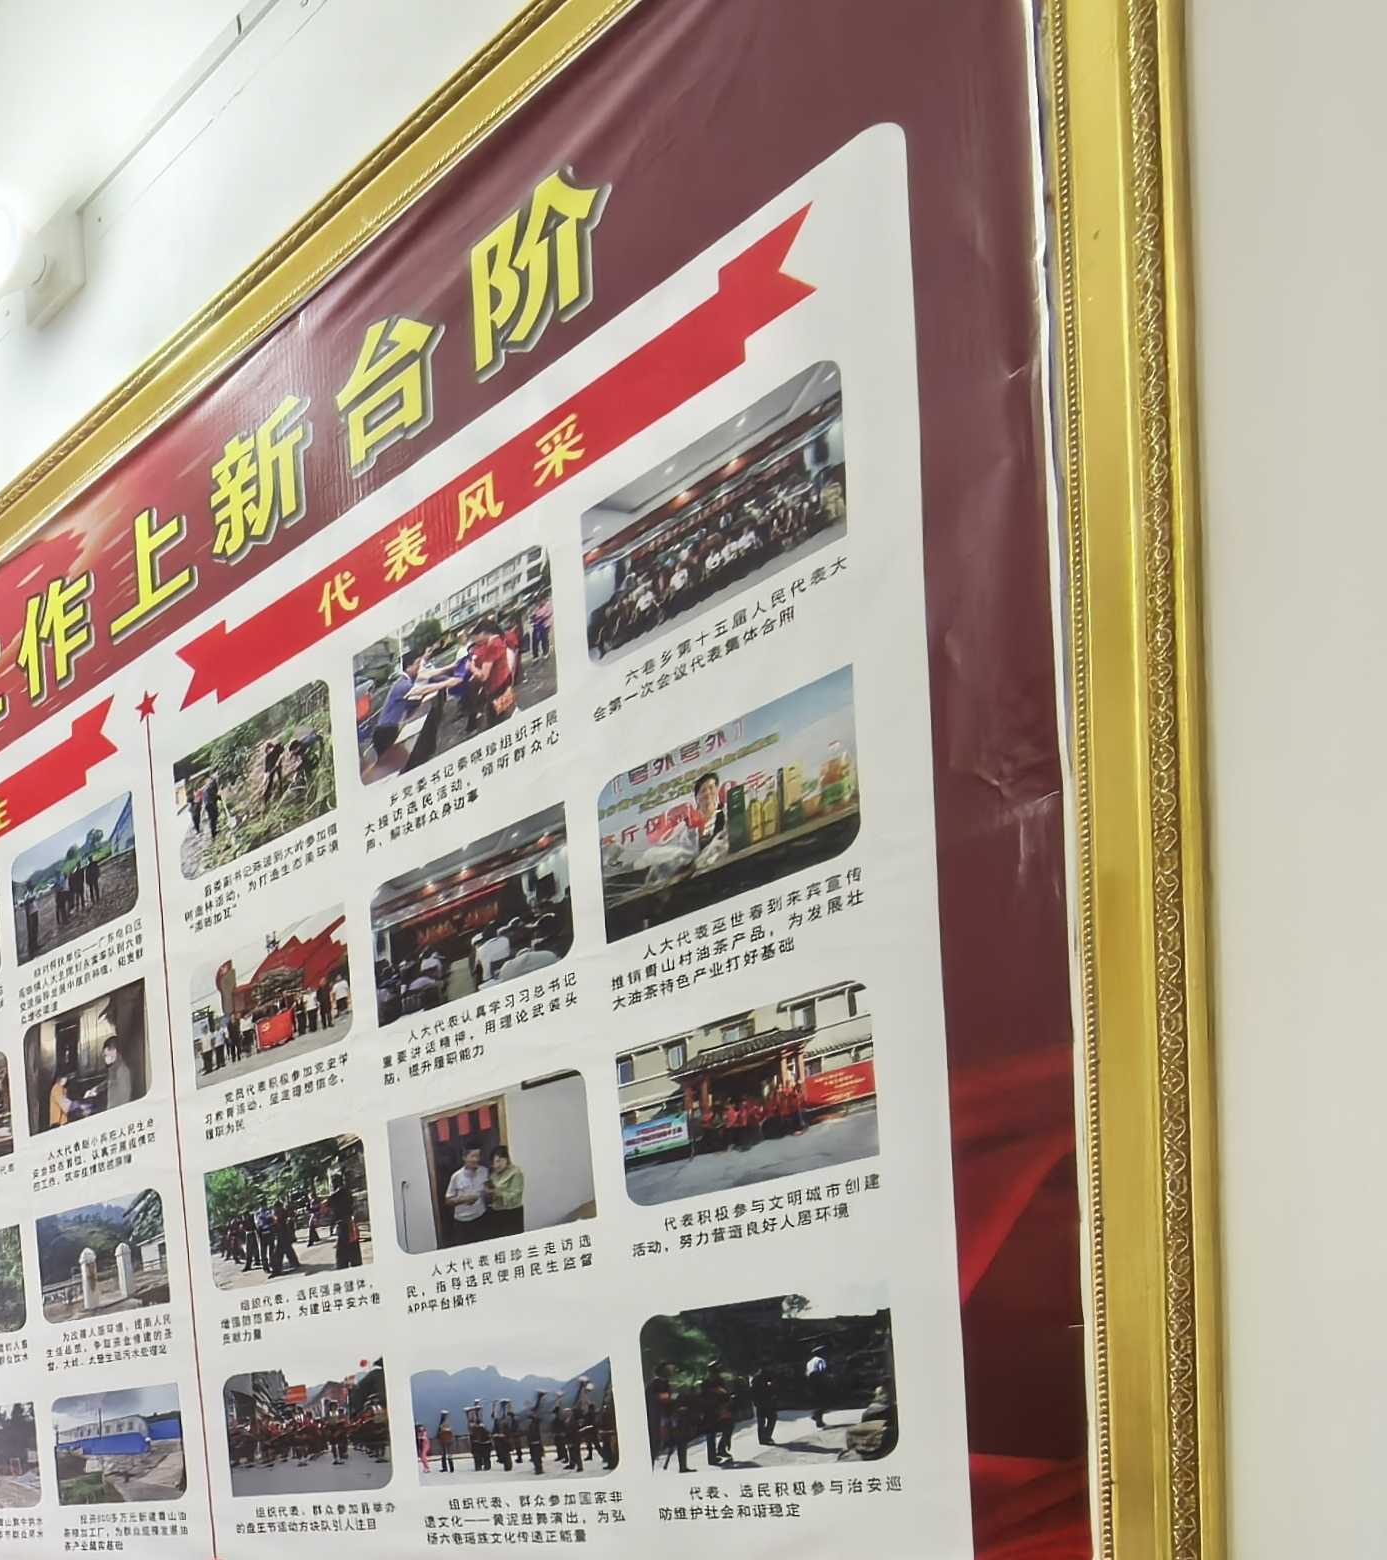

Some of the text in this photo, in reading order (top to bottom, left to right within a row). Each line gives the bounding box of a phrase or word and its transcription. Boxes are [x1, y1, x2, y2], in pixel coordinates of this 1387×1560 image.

[318, 413, 585, 627] 代表风采
[625, 555, 847, 686] 六巷乡第十五届人民代表大
[593, 605, 795, 722] 会第一次会议代表集体合照
[407, 972, 577, 1043] 人大代表认真学习习总书记
[612, 936, 795, 1011] 大油茶特色产业打好基础
[632, 1203, 850, 1257] 活动，努力营造良好人居环境
[664, 1173, 880, 1231] 代表积极参与文明城市创建
[659, 1503, 801, 1520] 防维护社会和谐稳定
[689, 1475, 903, 1500] 代表、选民积极参与治安巡
